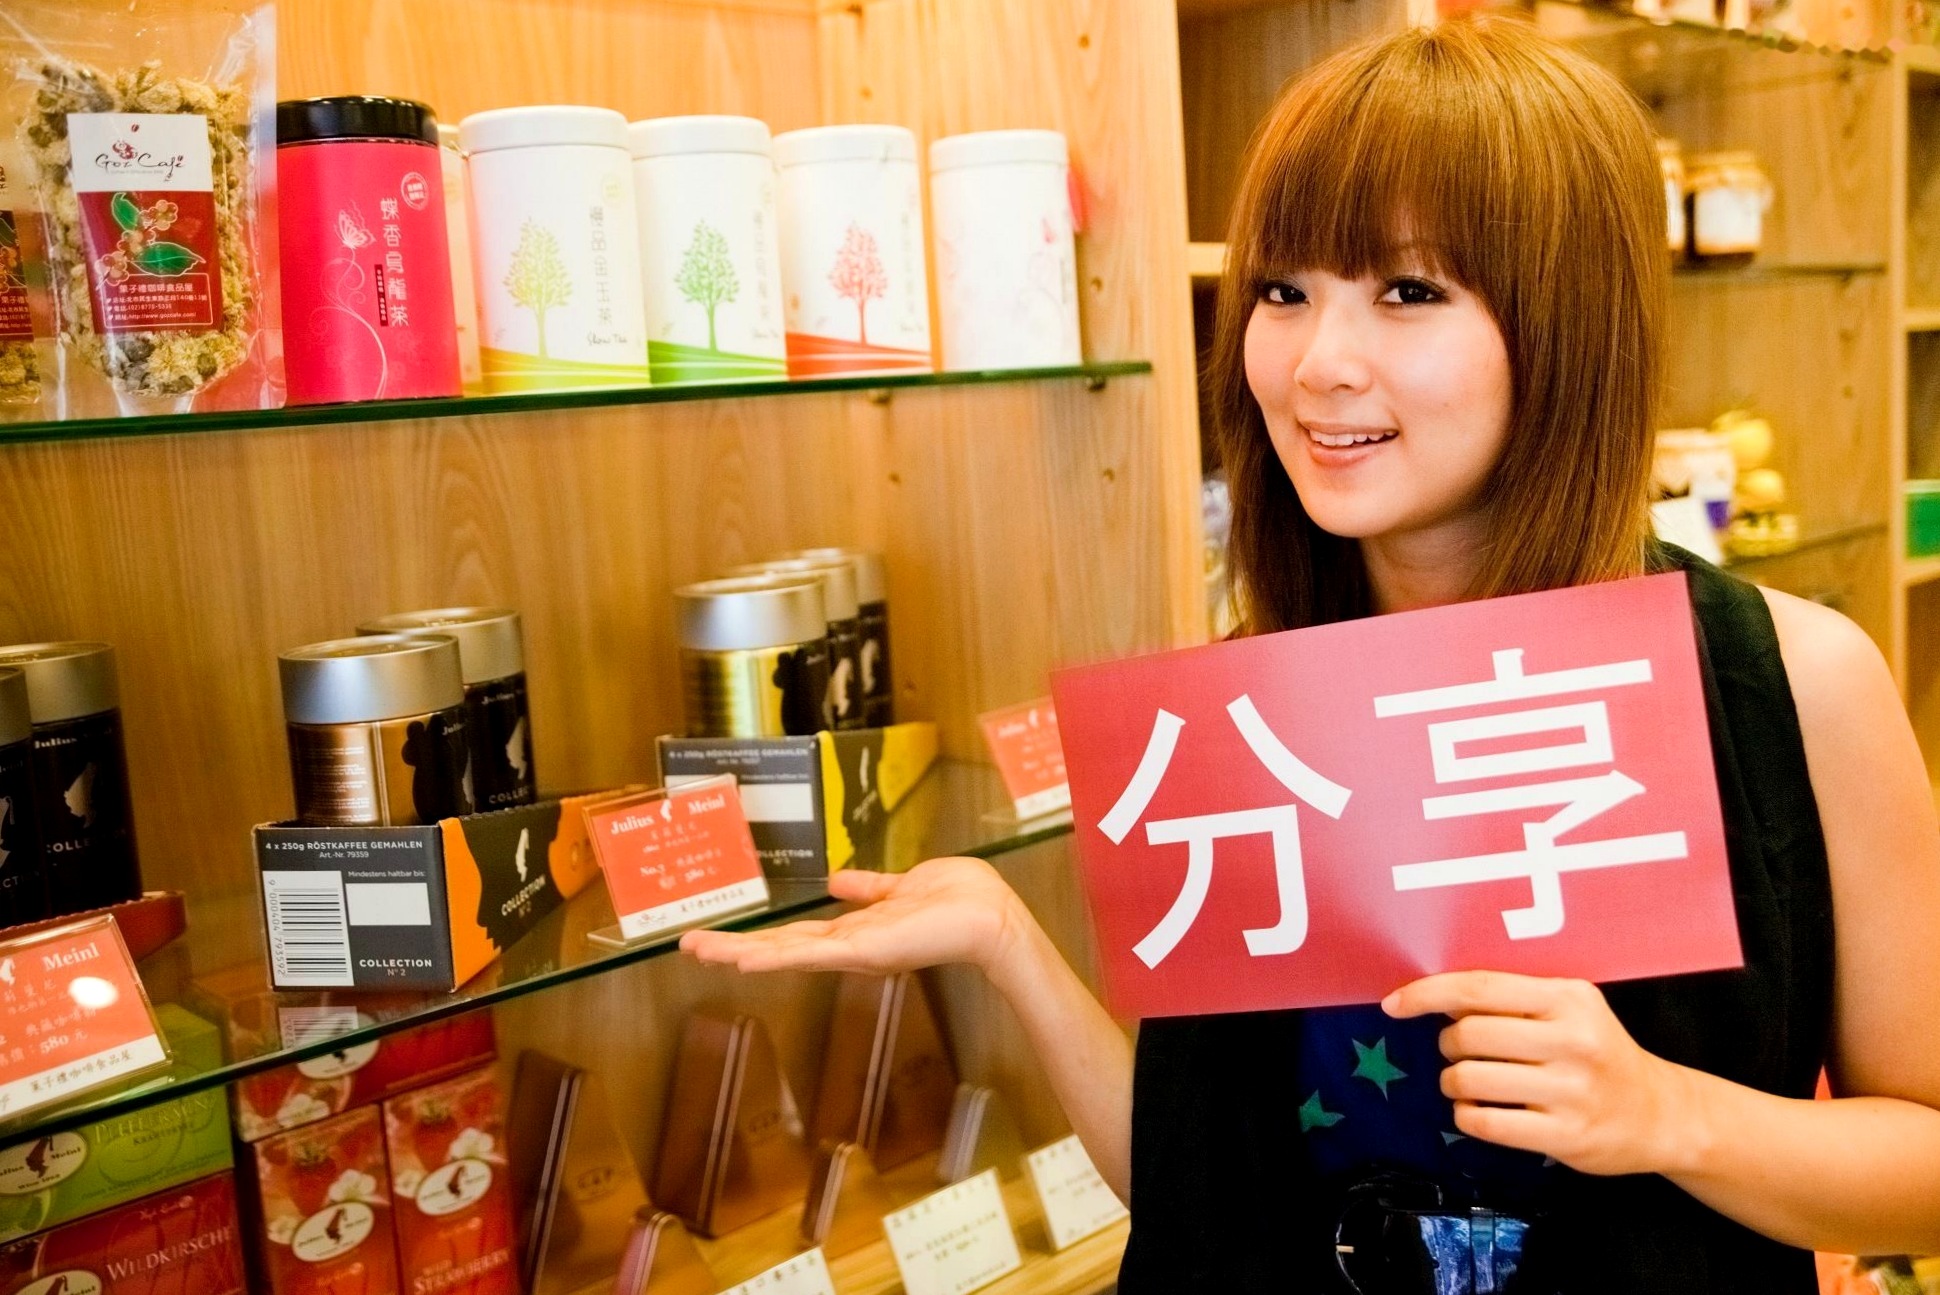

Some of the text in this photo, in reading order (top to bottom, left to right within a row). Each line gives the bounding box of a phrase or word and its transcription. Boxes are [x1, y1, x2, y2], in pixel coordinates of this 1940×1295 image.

[610, 814, 655, 836] Julius
[688, 794, 727, 816] Meinl
[1097, 647, 1690, 970] 分享
[265, 842, 272, 850] 4
[281, 842, 305, 851] 250g
[307, 840, 367, 850] RÖSTKAFFEE
[370, 840, 423, 850] GEMAHLEN
[346, 851, 370, 859] 79359
[348, 870, 387, 878] Mindestens
[387, 870, 412, 878] haltbar
[501, 874, 546, 917] COLLECTION
[42, 942, 101, 972] Meinl
[359, 959, 433, 968] COLLECTION
[400, 968, 407, 977] 2
[39, 1034, 70, 1055] 580
